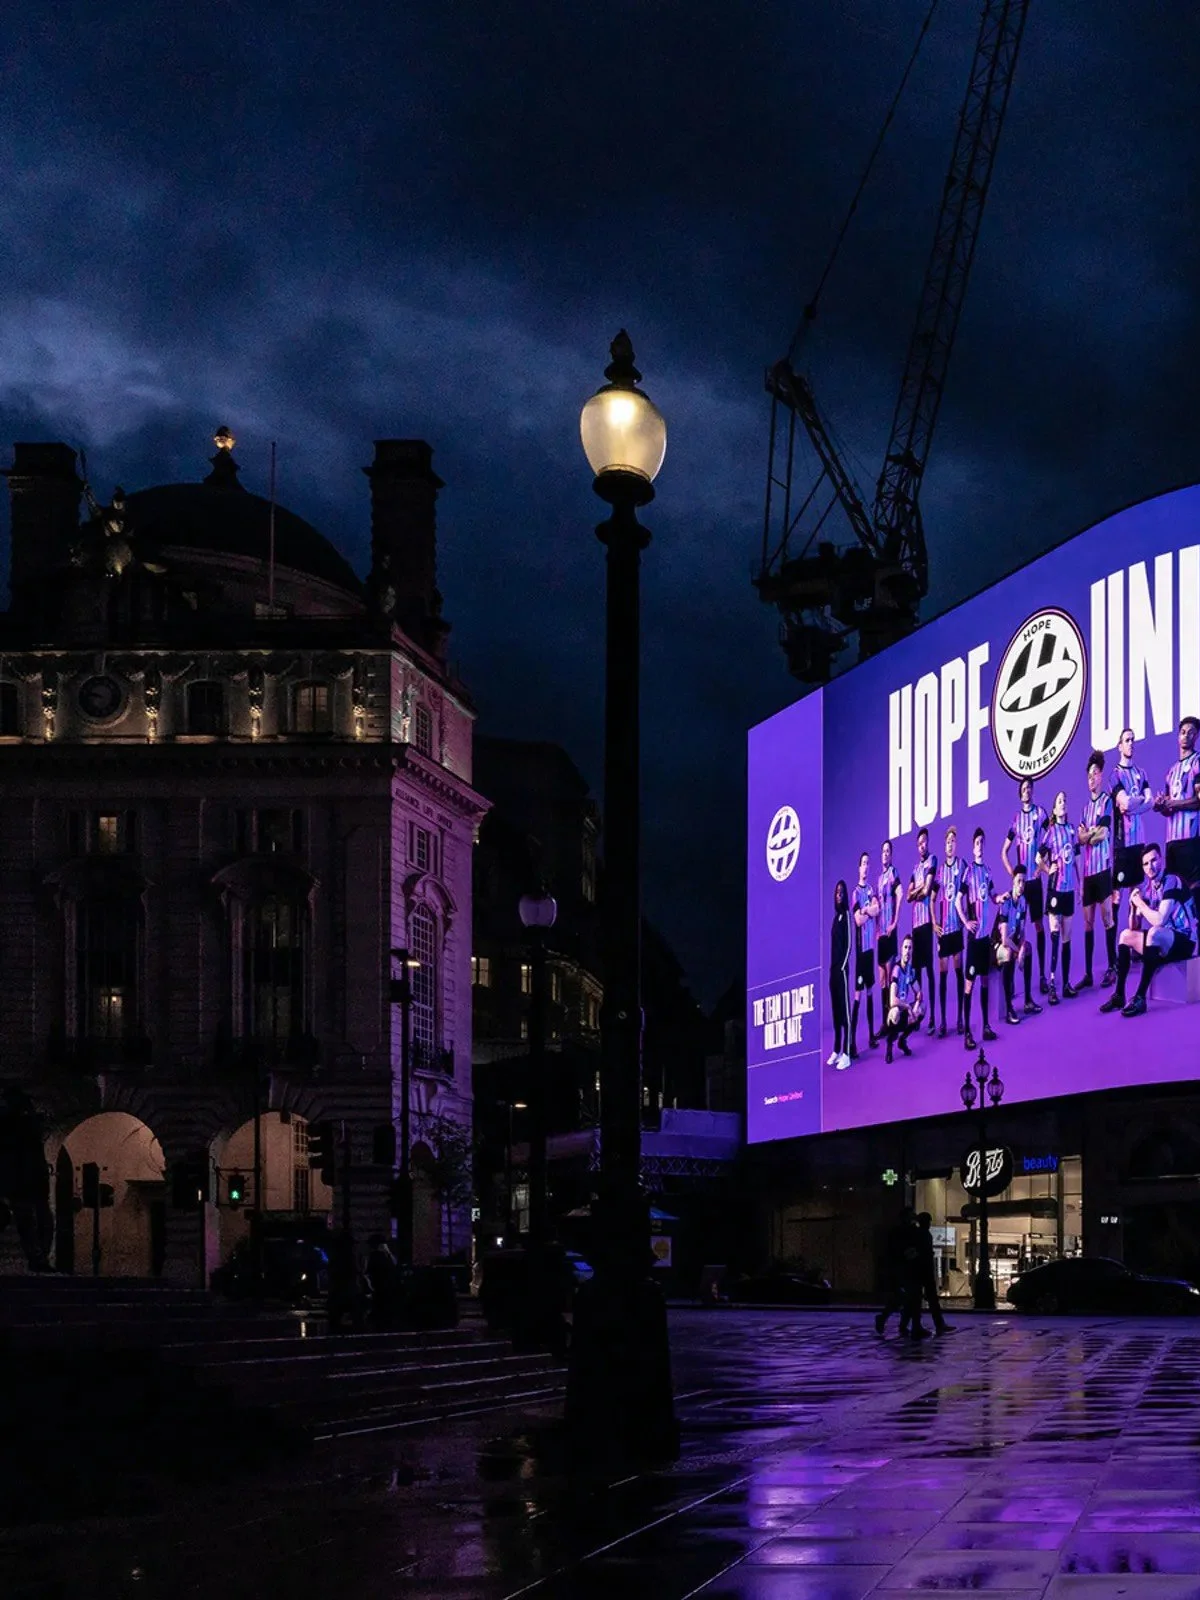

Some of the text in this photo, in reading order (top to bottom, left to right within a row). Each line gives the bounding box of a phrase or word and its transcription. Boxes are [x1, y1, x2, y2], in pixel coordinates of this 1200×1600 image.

[1023, 619, 1051, 641] HOPE
[889, 642, 989, 838] HOPE
[1018, 746, 1057, 770] UNITED
[1024, 1154, 1058, 1171] beauty
